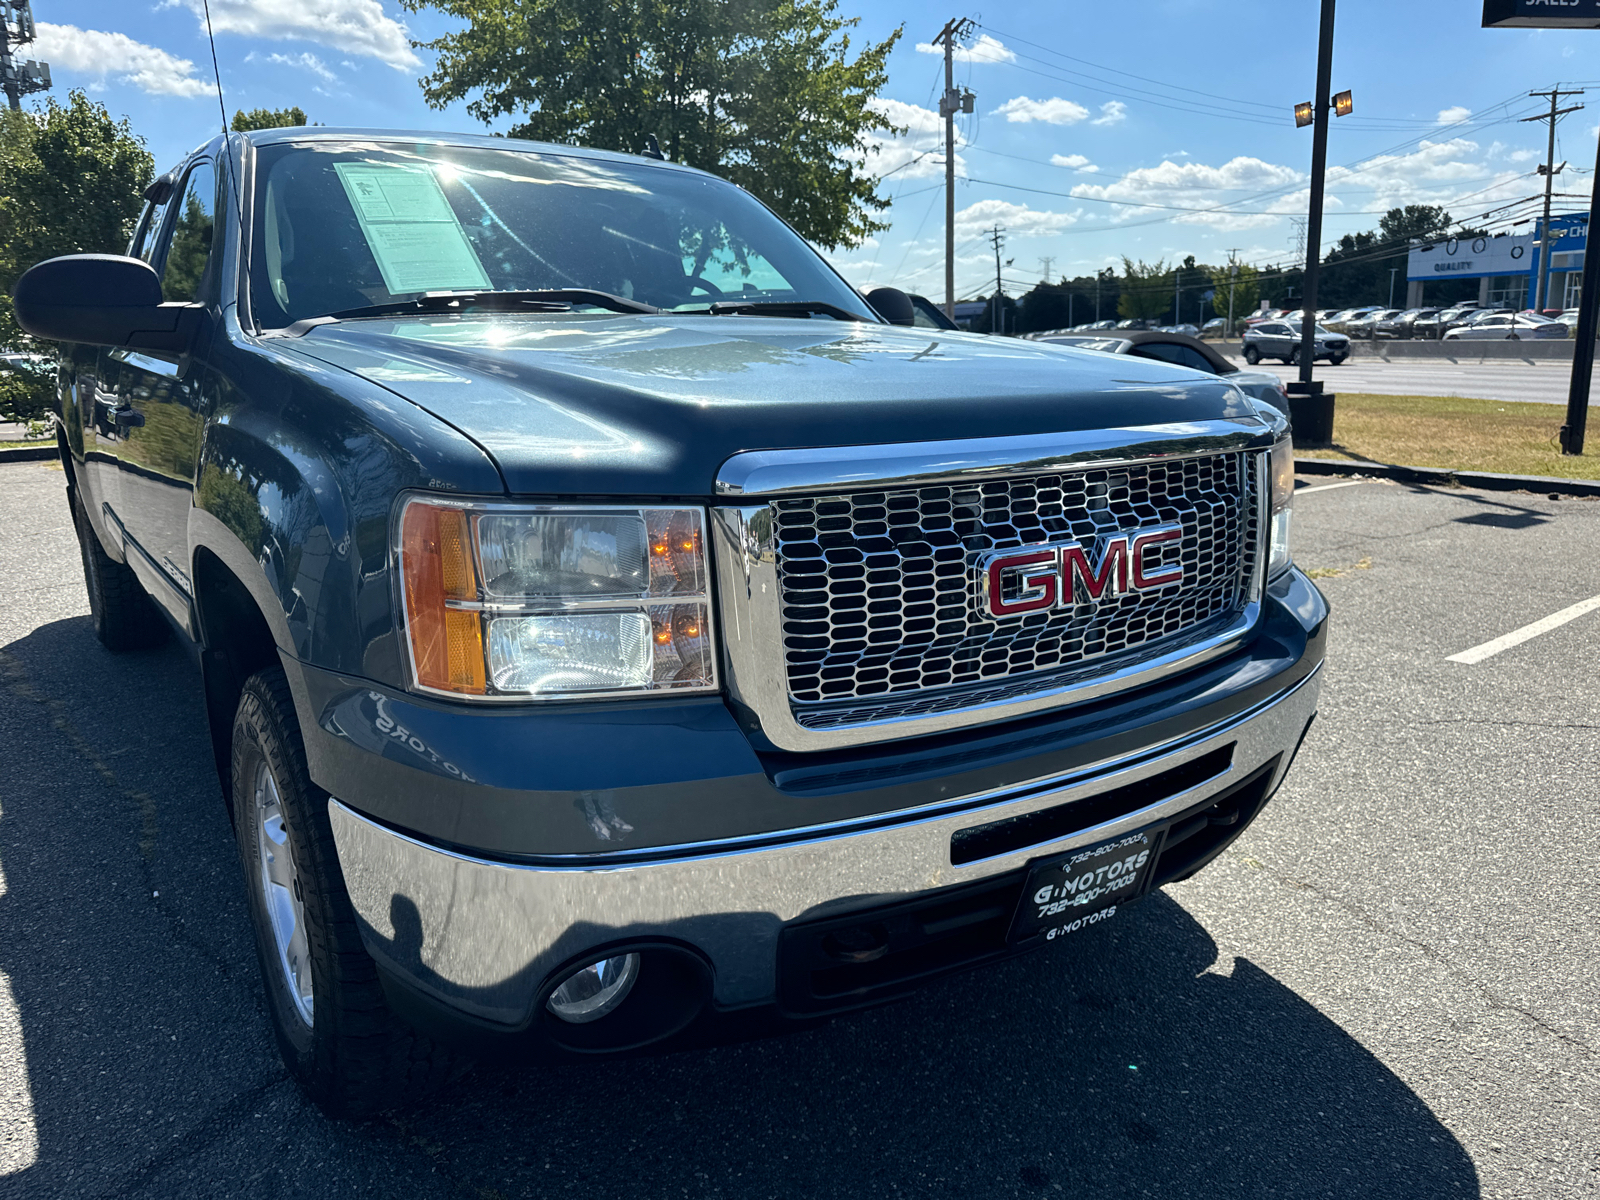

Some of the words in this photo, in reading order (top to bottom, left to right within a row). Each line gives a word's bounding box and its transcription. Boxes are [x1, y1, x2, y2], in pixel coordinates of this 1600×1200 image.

[1434, 261, 1473, 273] QUALITY
[984, 525, 1184, 618] GMC
[1069, 832, 1144, 866] 732-800-7003
[1037, 871, 1137, 918] 732-800-7003
